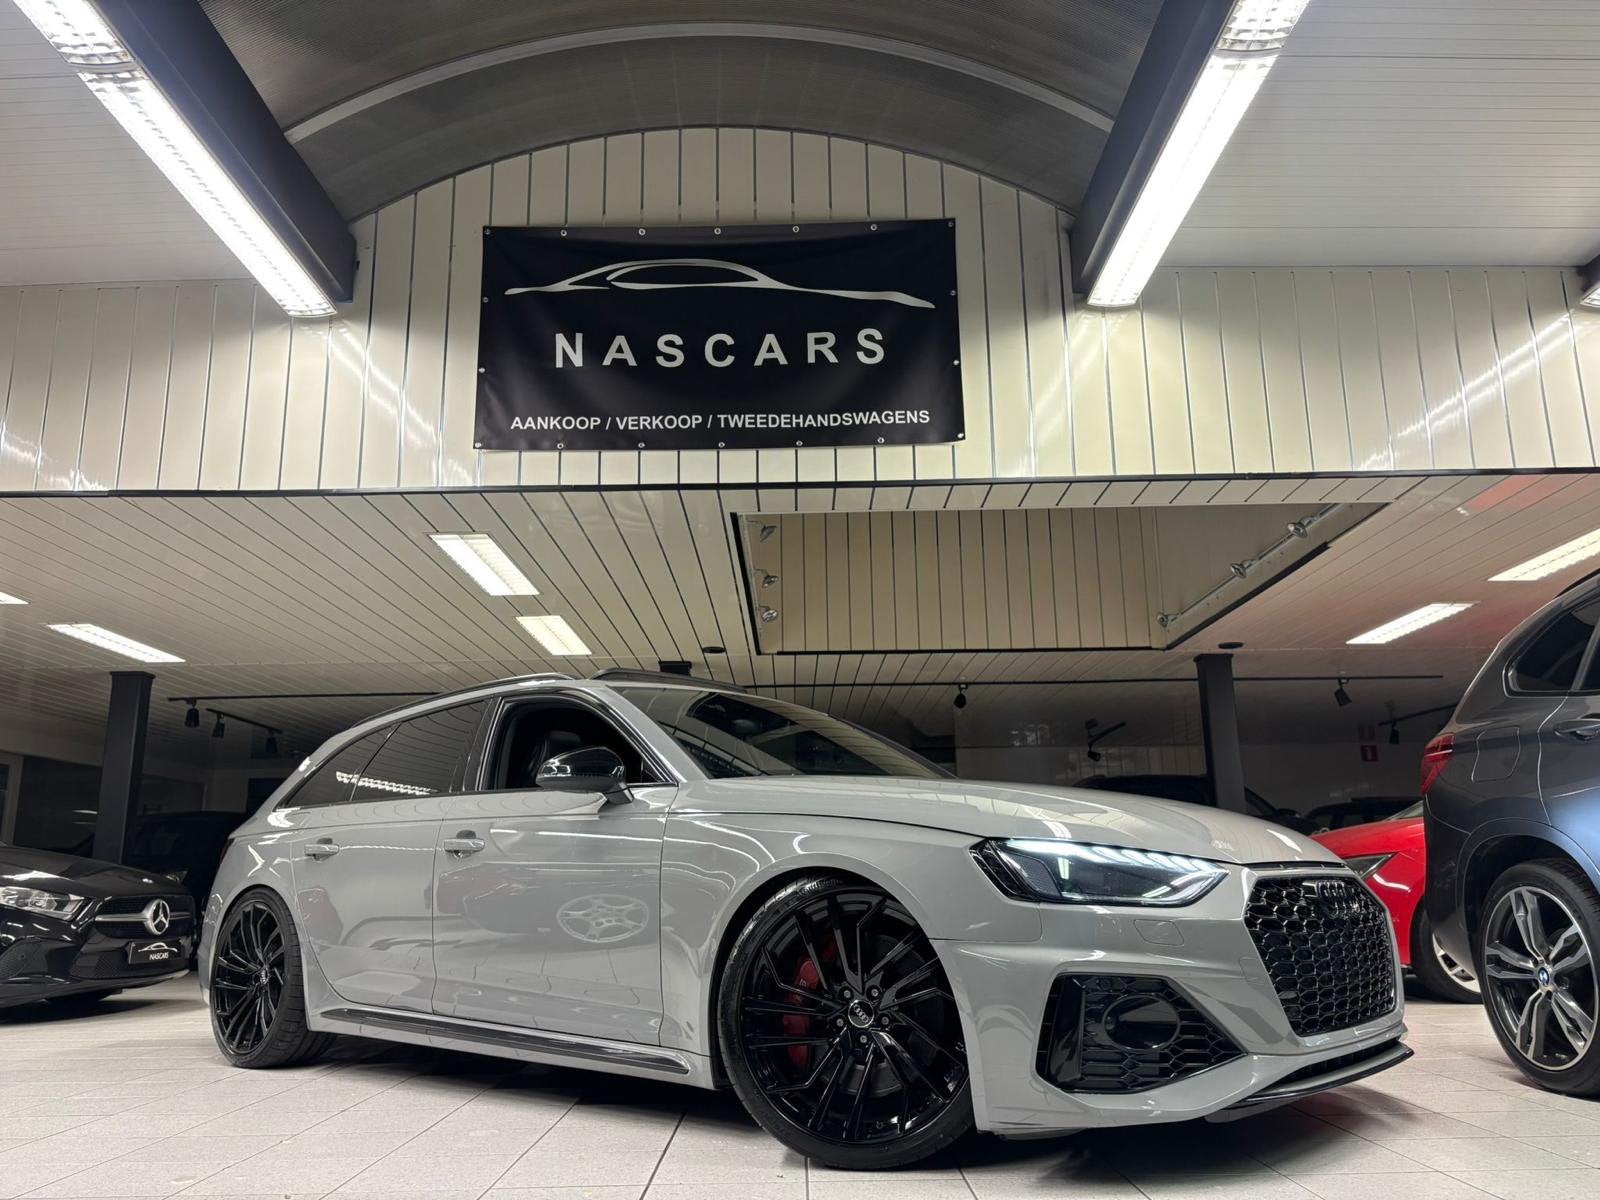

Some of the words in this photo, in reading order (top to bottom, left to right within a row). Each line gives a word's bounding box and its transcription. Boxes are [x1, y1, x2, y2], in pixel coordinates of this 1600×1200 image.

[555, 328, 885, 369] NASCARS
[510, 416, 601, 431] AANKOOP
[615, 414, 703, 431] VERKOOP
[717, 410, 931, 428] TWEEDEHANDSWAGENS
